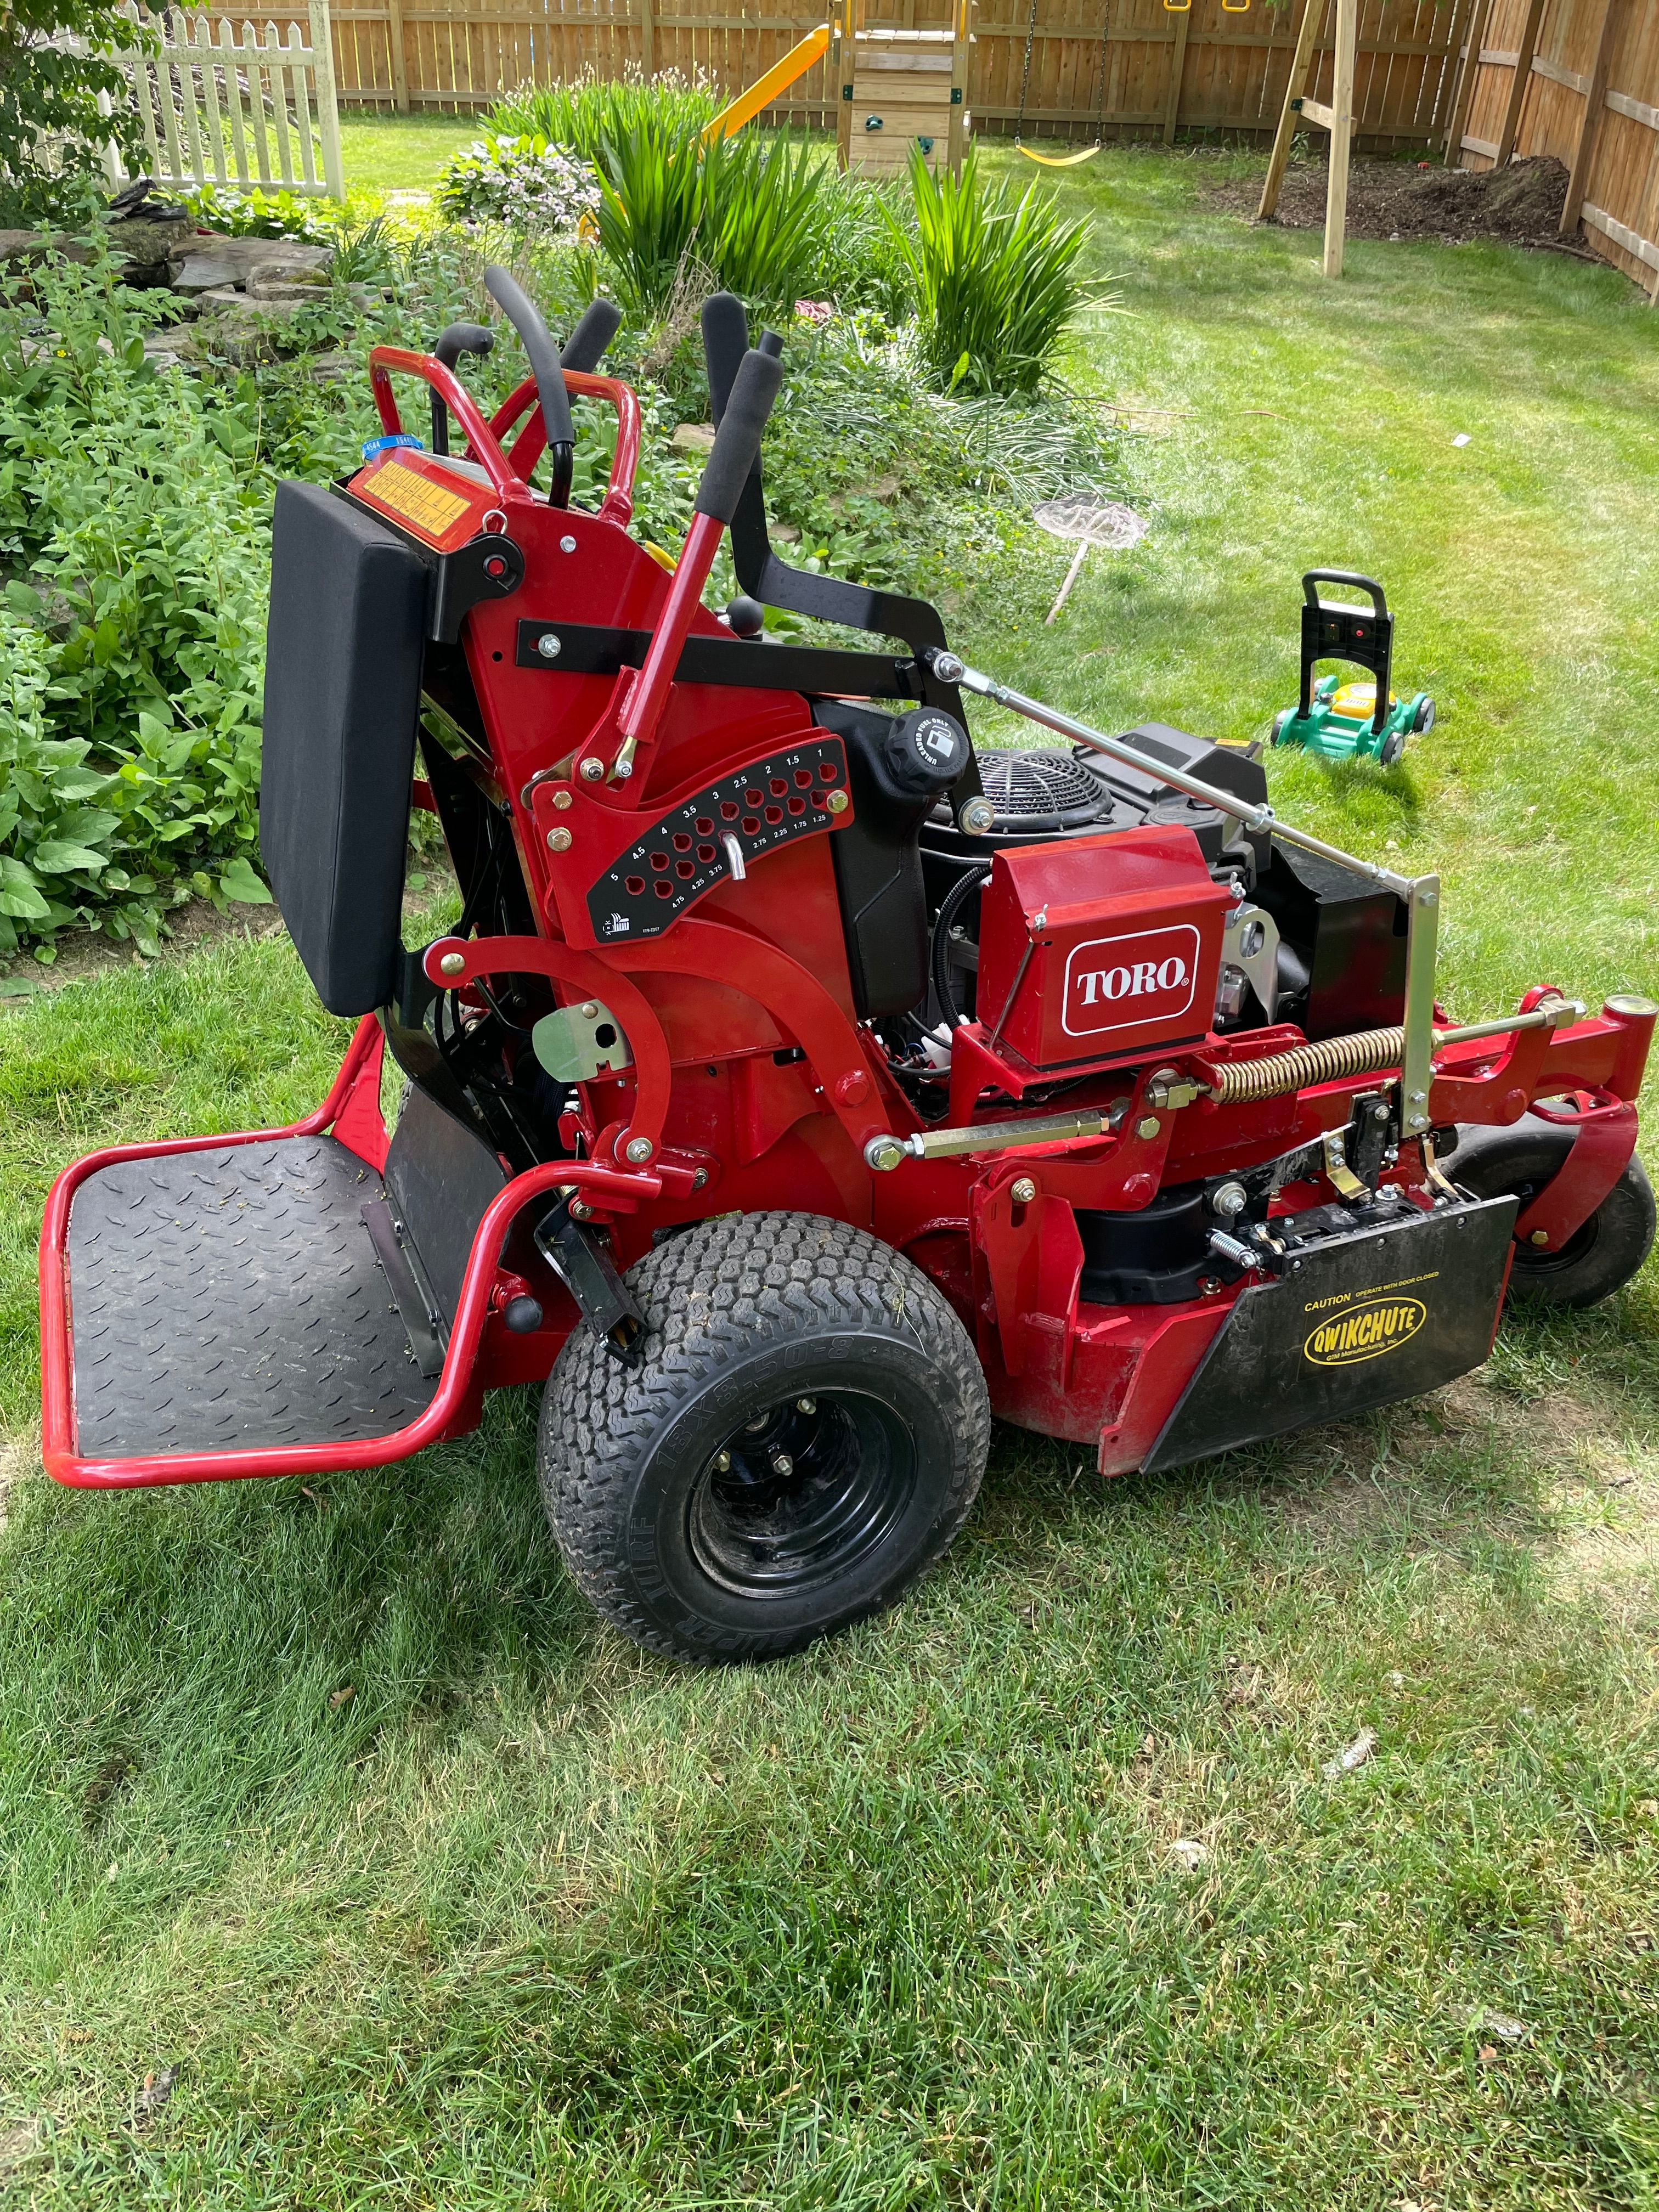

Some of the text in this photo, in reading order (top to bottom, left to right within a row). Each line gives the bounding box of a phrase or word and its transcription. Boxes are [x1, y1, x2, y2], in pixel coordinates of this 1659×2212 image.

[916, 718, 949, 765] UNLEADED FUEL ONLY
[611, 873, 619, 881] 5
[633, 846, 645, 860] 4.5
[682, 805, 697, 818] 3.5
[712, 791, 719, 799] 3
[733, 776, 747, 788] 2.5
[765, 765, 772, 774] 2
[786, 755, 799, 766] 1.5
[817, 749, 822, 757] 1
[672, 814, 826, 909] 4.75 4.25 3.75 2.75 2.25 1.75 1.25
[1305, 1293, 1351, 1312] CAUTION
[1355, 1286, 1383, 1297] OPERATE
[1398, 1278, 1415, 1286] DOOR
[1416, 1271, 1439, 1282] CLOSED
[1313, 1306, 1416, 1353] QWIKCHUTE
[1326, 1353, 1340, 1361] GTM
